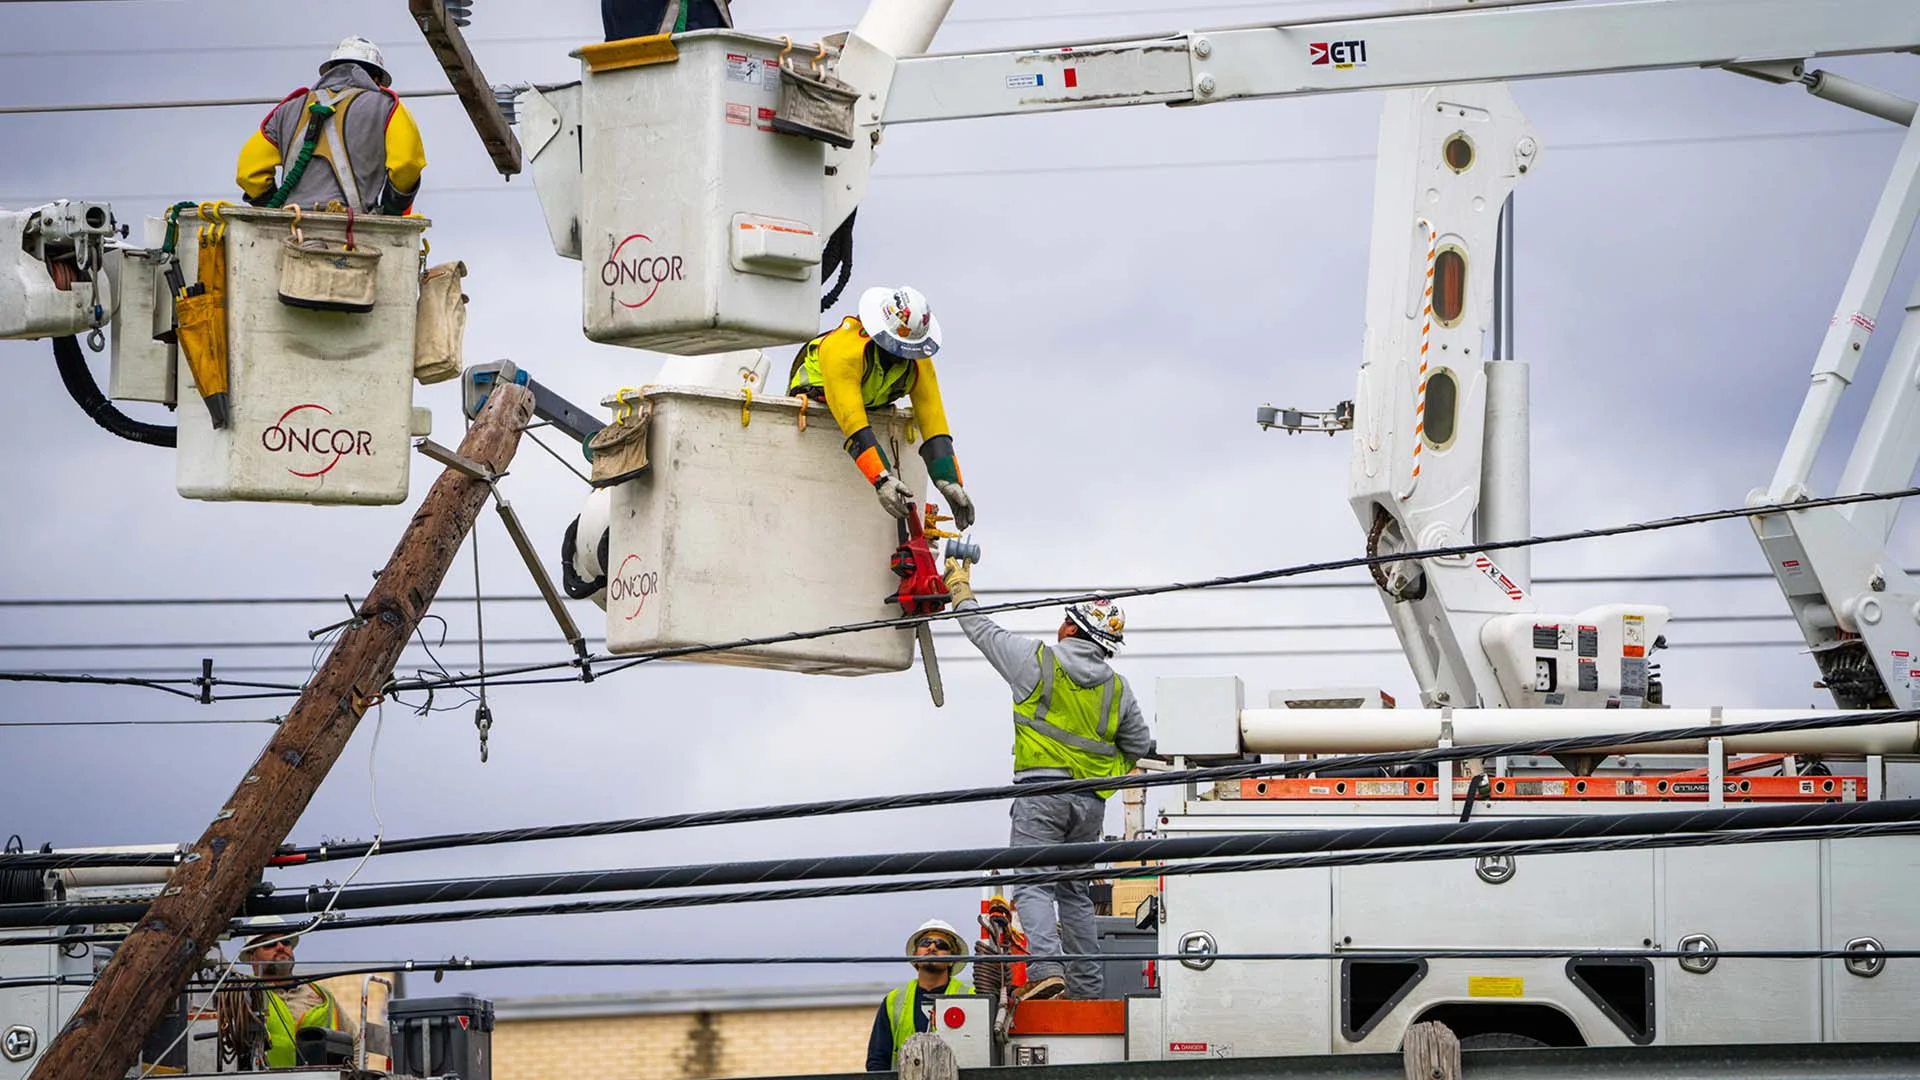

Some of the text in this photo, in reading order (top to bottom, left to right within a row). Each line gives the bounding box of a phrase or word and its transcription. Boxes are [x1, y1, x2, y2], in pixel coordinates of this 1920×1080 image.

[1330, 40, 1367, 63] ETI
[601, 256, 682, 286] ONCOR
[262, 426, 372, 455] ONCOR
[611, 572, 658, 600] ONCOR
